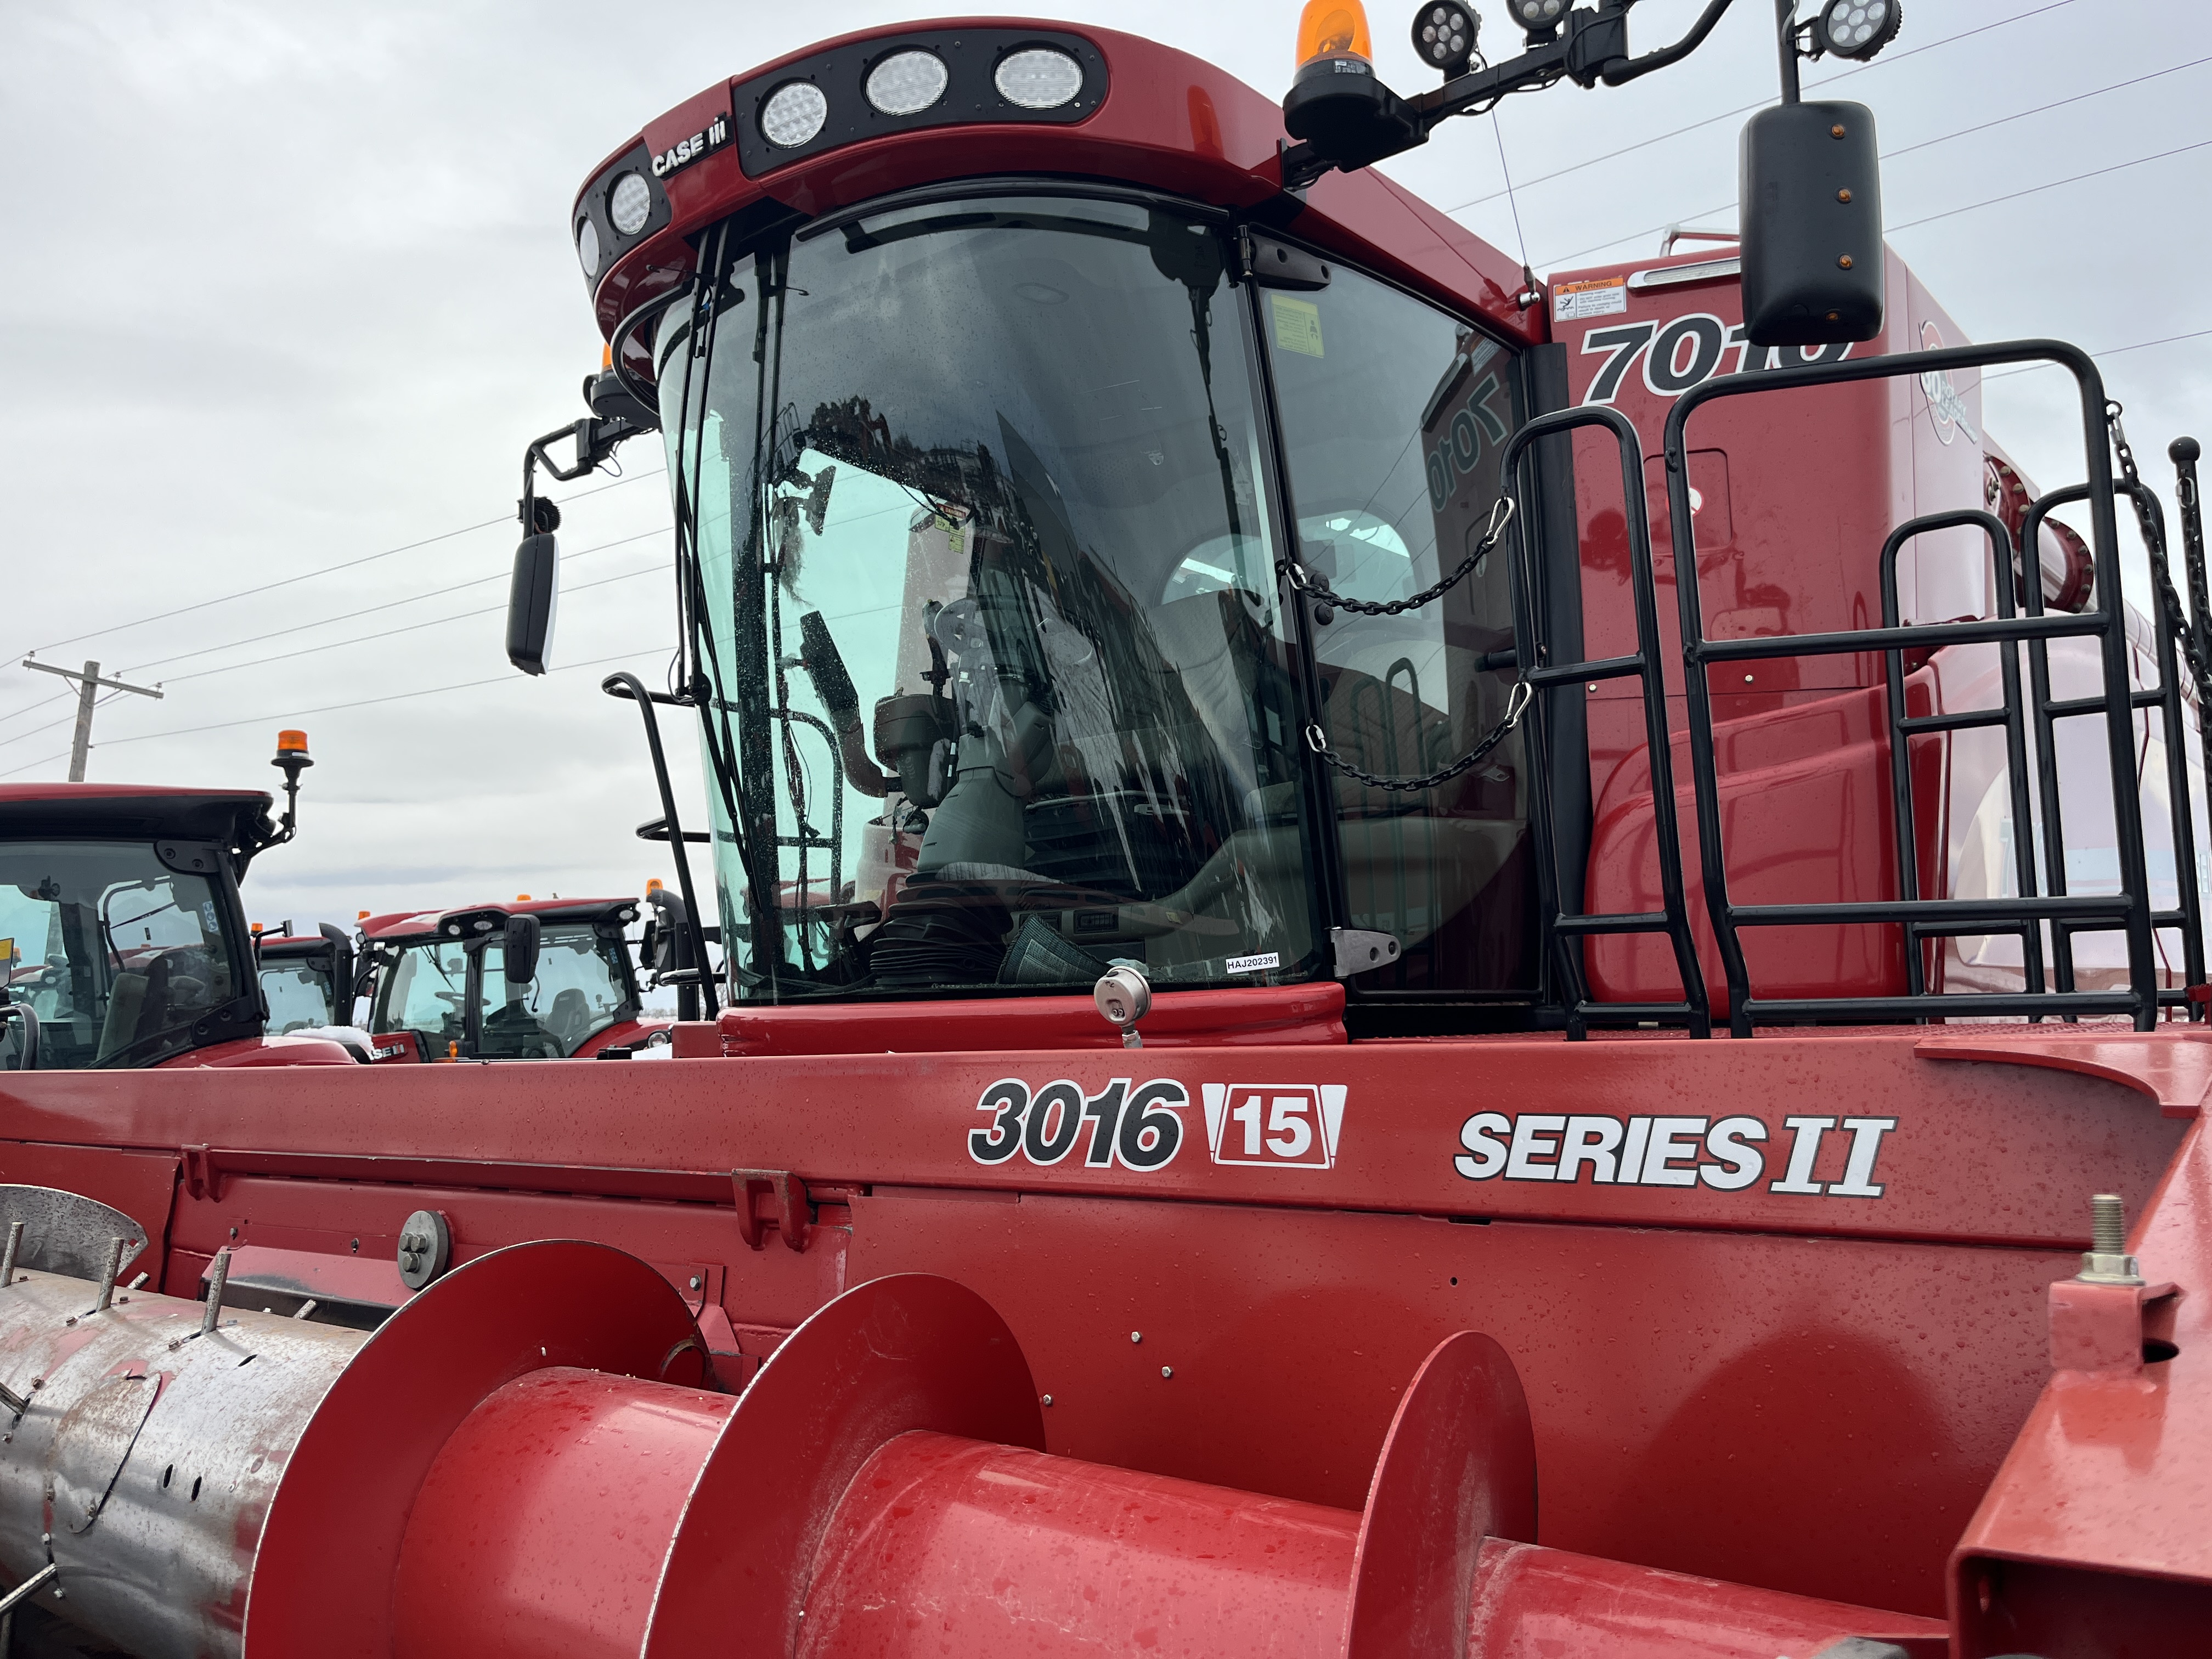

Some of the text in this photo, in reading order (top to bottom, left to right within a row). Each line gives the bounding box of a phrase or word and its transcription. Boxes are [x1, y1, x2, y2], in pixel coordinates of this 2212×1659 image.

[652, 133, 704, 177] CASE
[1575, 280, 1612, 291] WARNING
[1227, 956, 1277, 969] HAJ202391
[968, 1077, 1312, 1172] 3016 15
[1452, 1110, 1900, 1200] SERIES II
